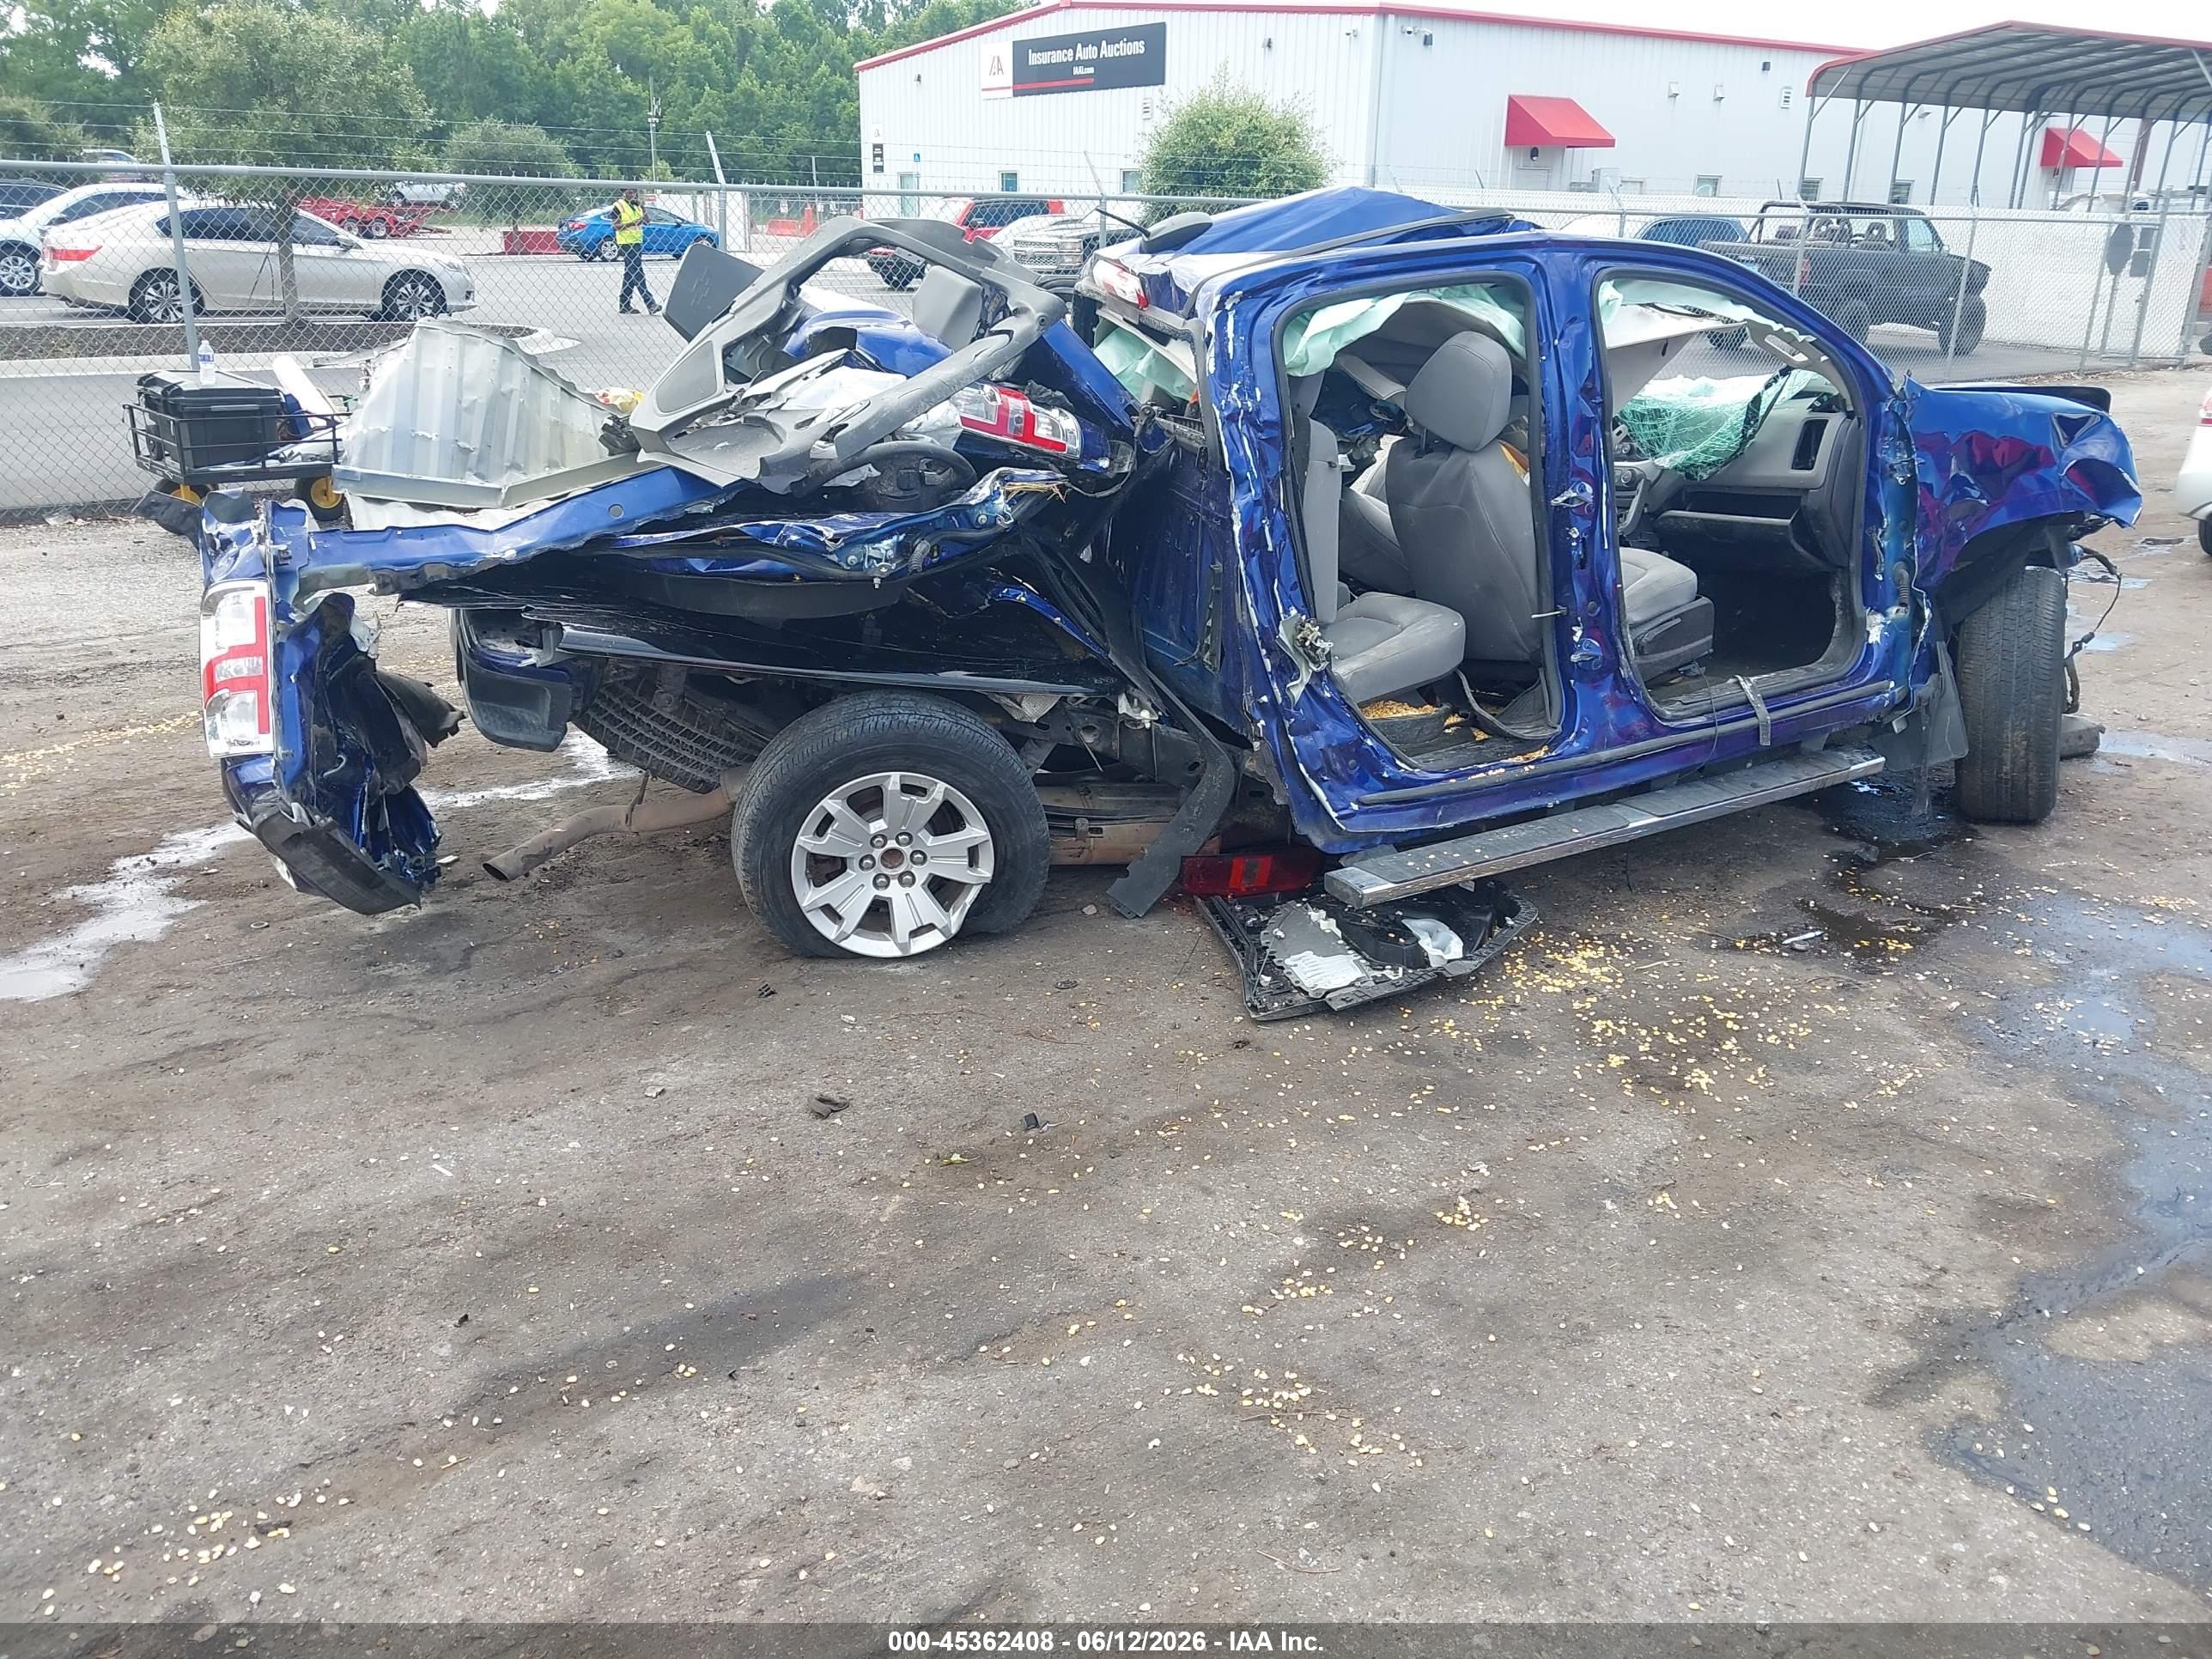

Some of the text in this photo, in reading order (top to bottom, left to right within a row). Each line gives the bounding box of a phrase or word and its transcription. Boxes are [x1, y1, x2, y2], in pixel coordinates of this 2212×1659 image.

[1028, 37, 1146, 66] Insurance Auto Auctions
